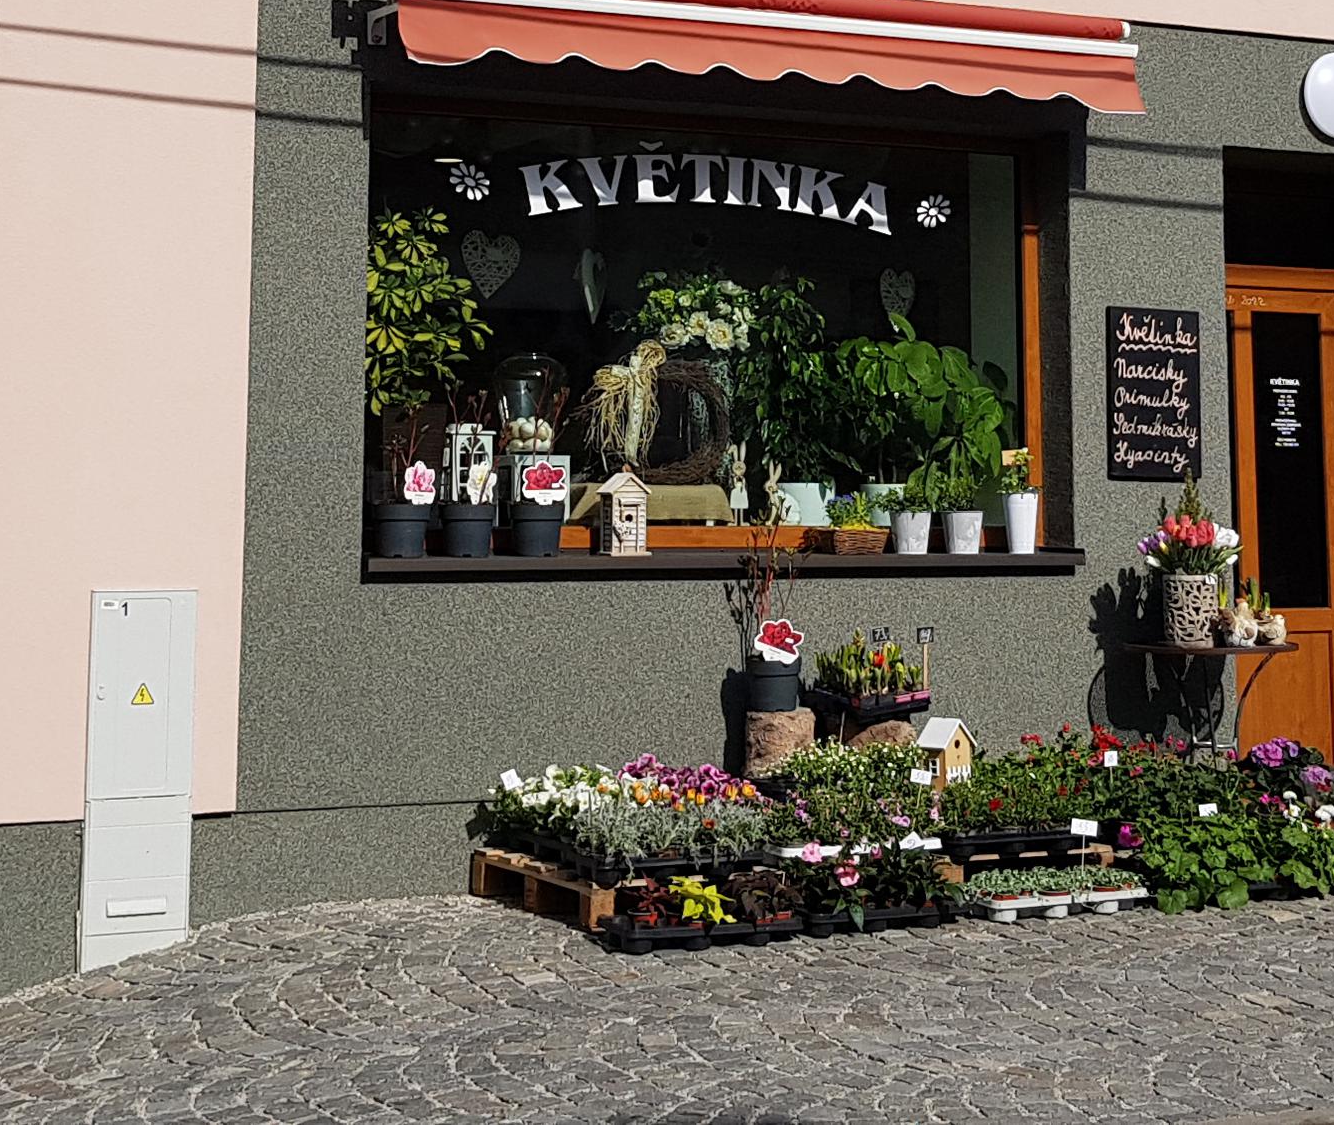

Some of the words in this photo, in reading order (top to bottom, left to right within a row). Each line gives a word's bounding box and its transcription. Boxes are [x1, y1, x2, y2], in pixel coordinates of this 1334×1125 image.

[519, 141, 891, 235] KVĚTINKA
[1116, 312, 1197, 346] Květinka
[1113, 357, 1188, 392] Narcisky
[1114, 386, 1190, 420] Primulky
[121, 601, 129, 616] 1
